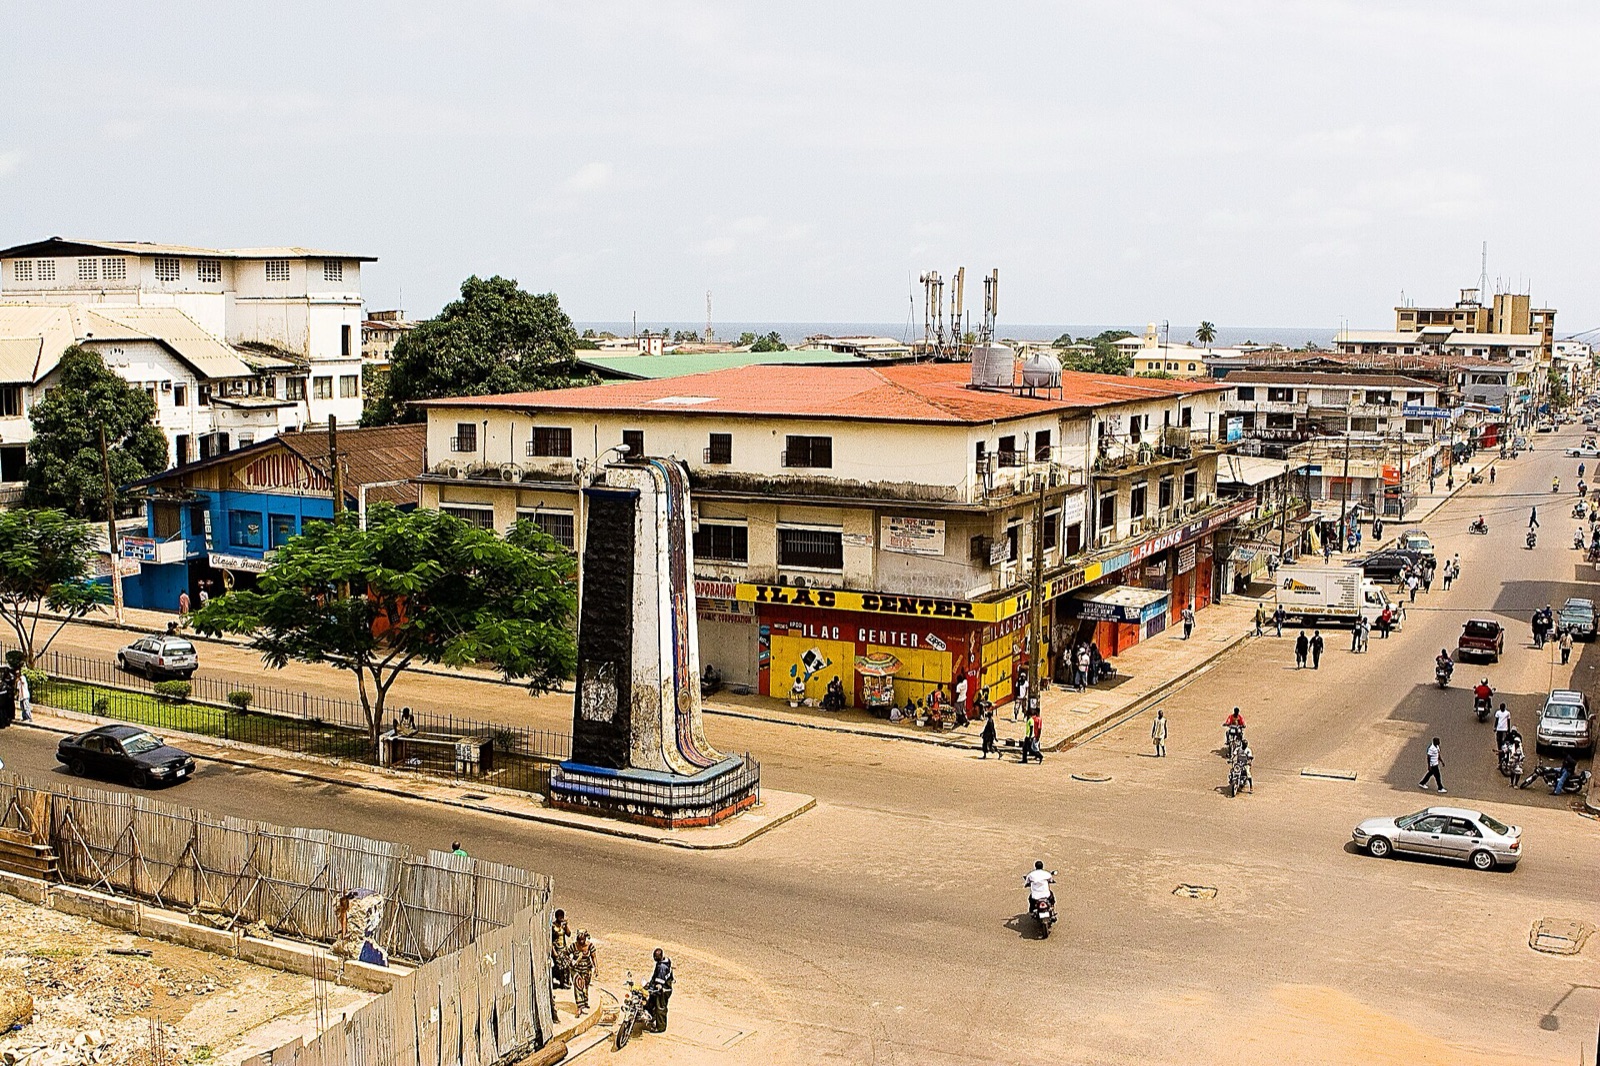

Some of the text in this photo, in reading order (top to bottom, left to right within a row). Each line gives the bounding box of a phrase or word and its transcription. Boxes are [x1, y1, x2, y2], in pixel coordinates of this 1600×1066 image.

[246, 453, 280, 487] PHOTO
[211, 555, 238, 567] Classic
[1051, 570, 1085, 597] CENTER
[756, 586, 835, 607] ILAC
[861, 594, 974, 618] CENTER
[803, 624, 918, 647] ILAC CENTER
